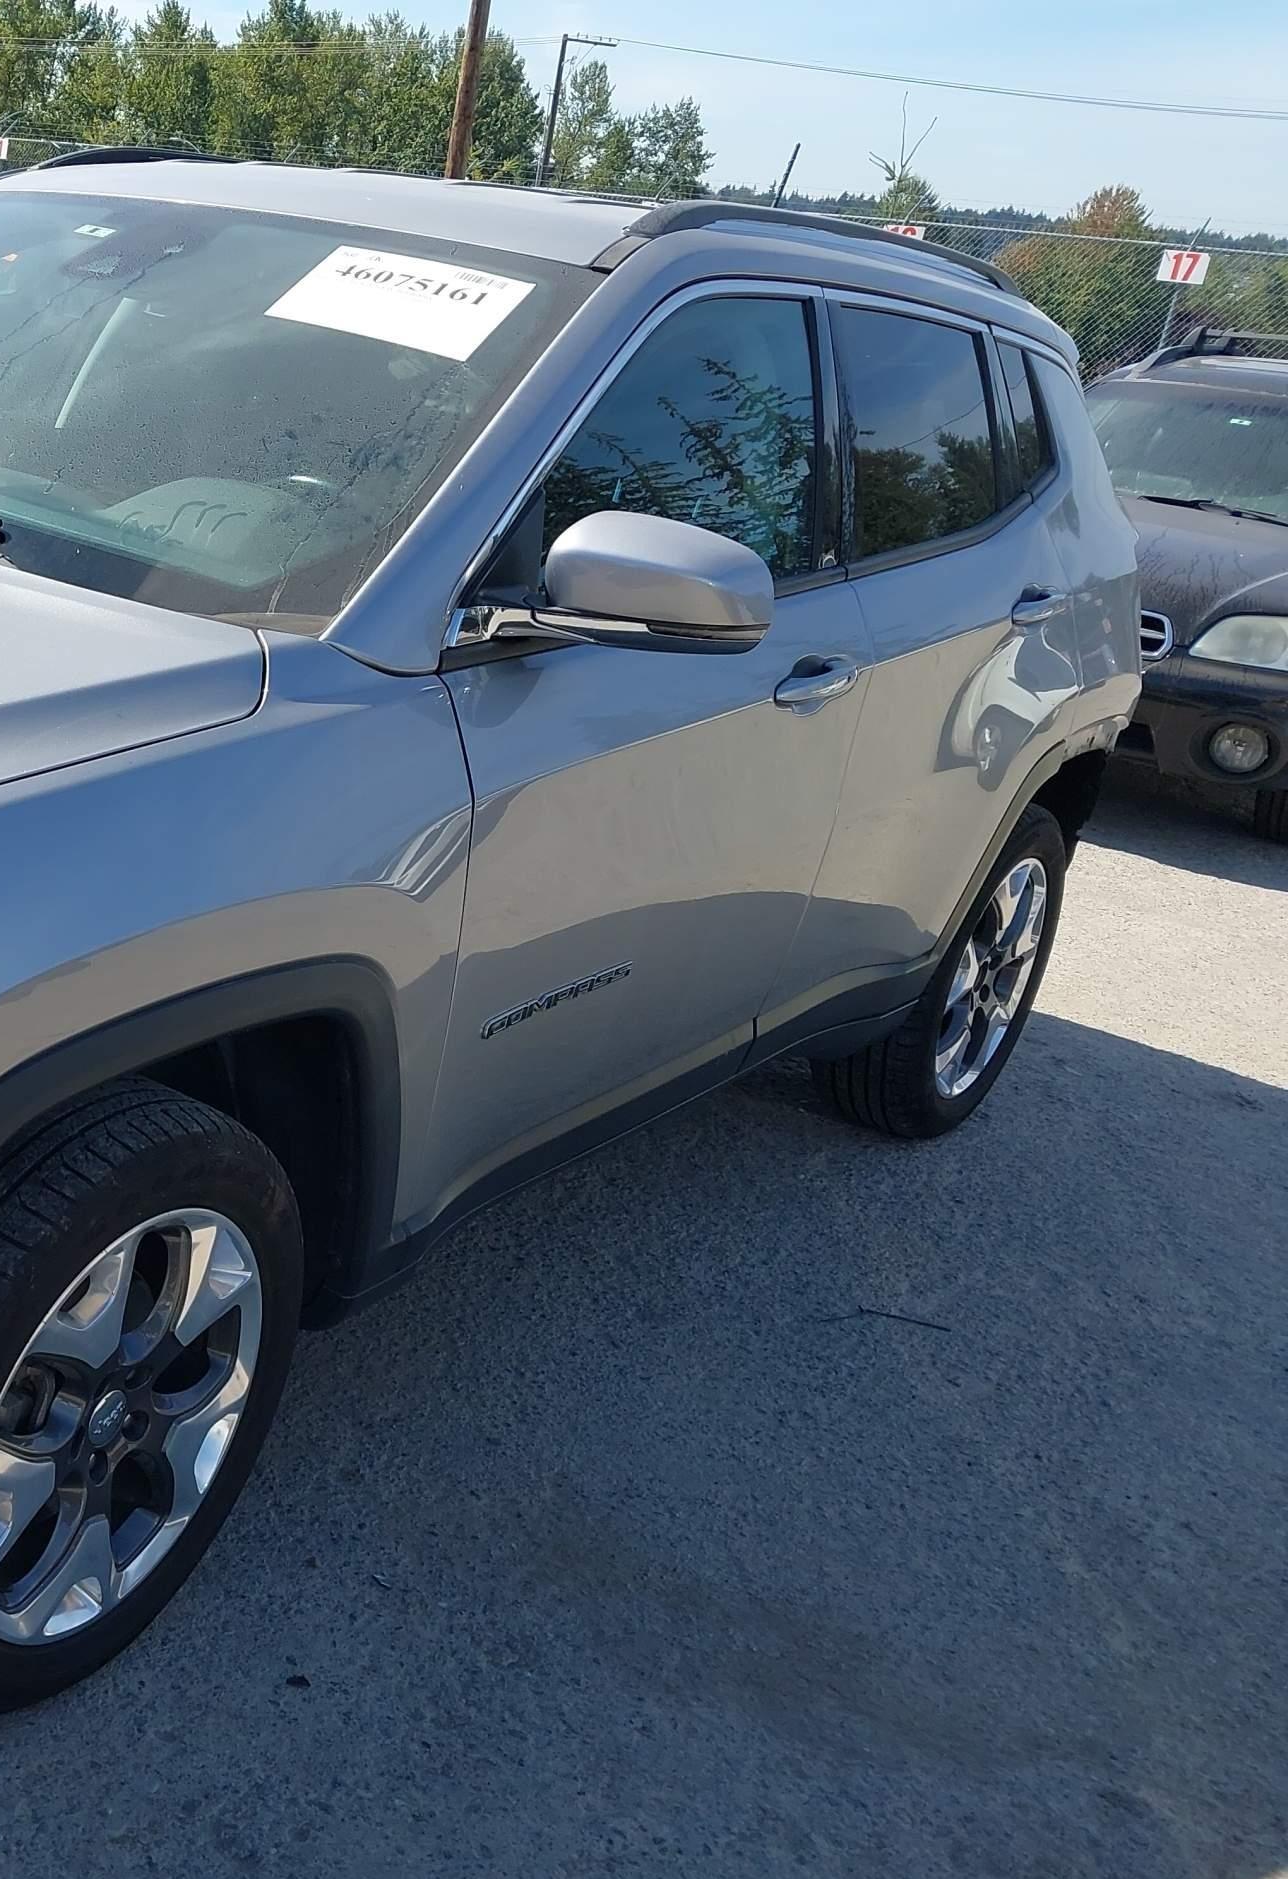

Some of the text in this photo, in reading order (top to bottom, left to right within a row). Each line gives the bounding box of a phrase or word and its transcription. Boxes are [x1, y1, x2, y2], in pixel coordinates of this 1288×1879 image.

[335, 264, 489, 306] 46075161
[1170, 252, 1202, 282] 17
[480, 959, 633, 1039] COMPASS
